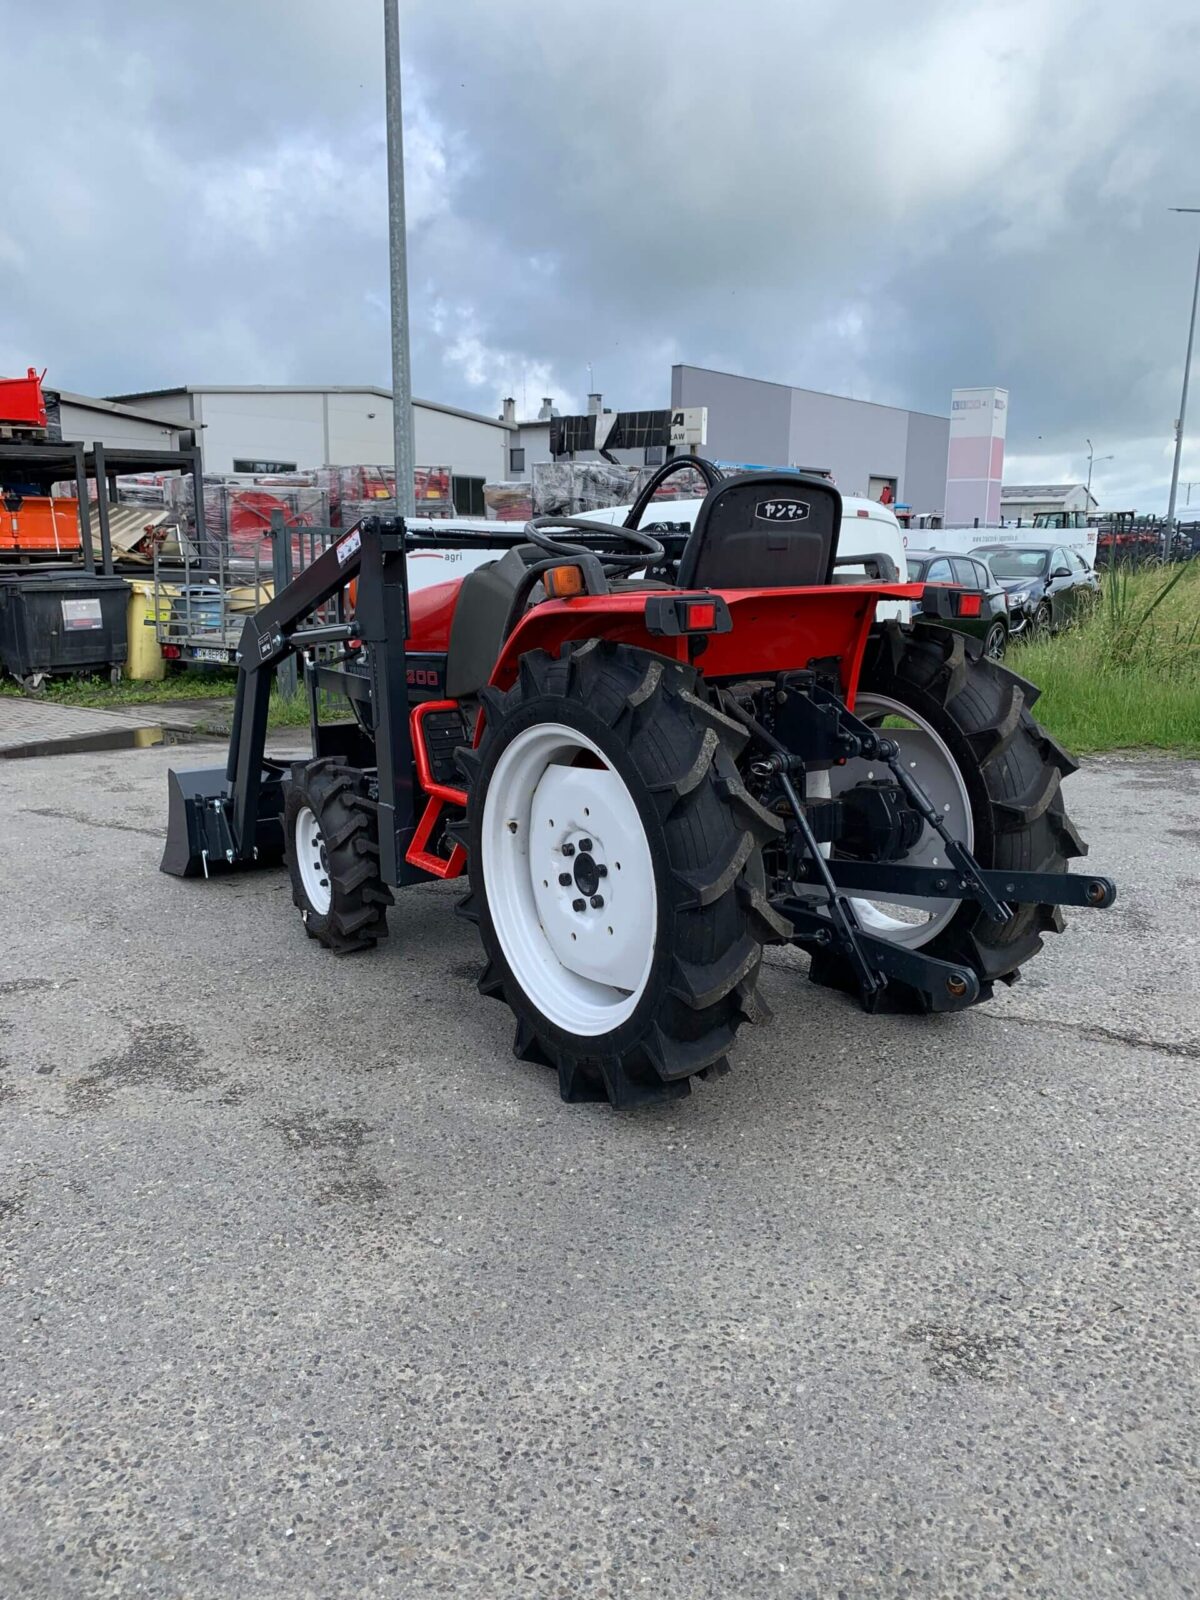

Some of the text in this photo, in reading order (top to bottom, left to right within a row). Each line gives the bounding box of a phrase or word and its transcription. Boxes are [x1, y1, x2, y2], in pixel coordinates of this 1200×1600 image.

[765, 503, 803, 518] ヤンマー
[444, 552, 463, 563] agri
